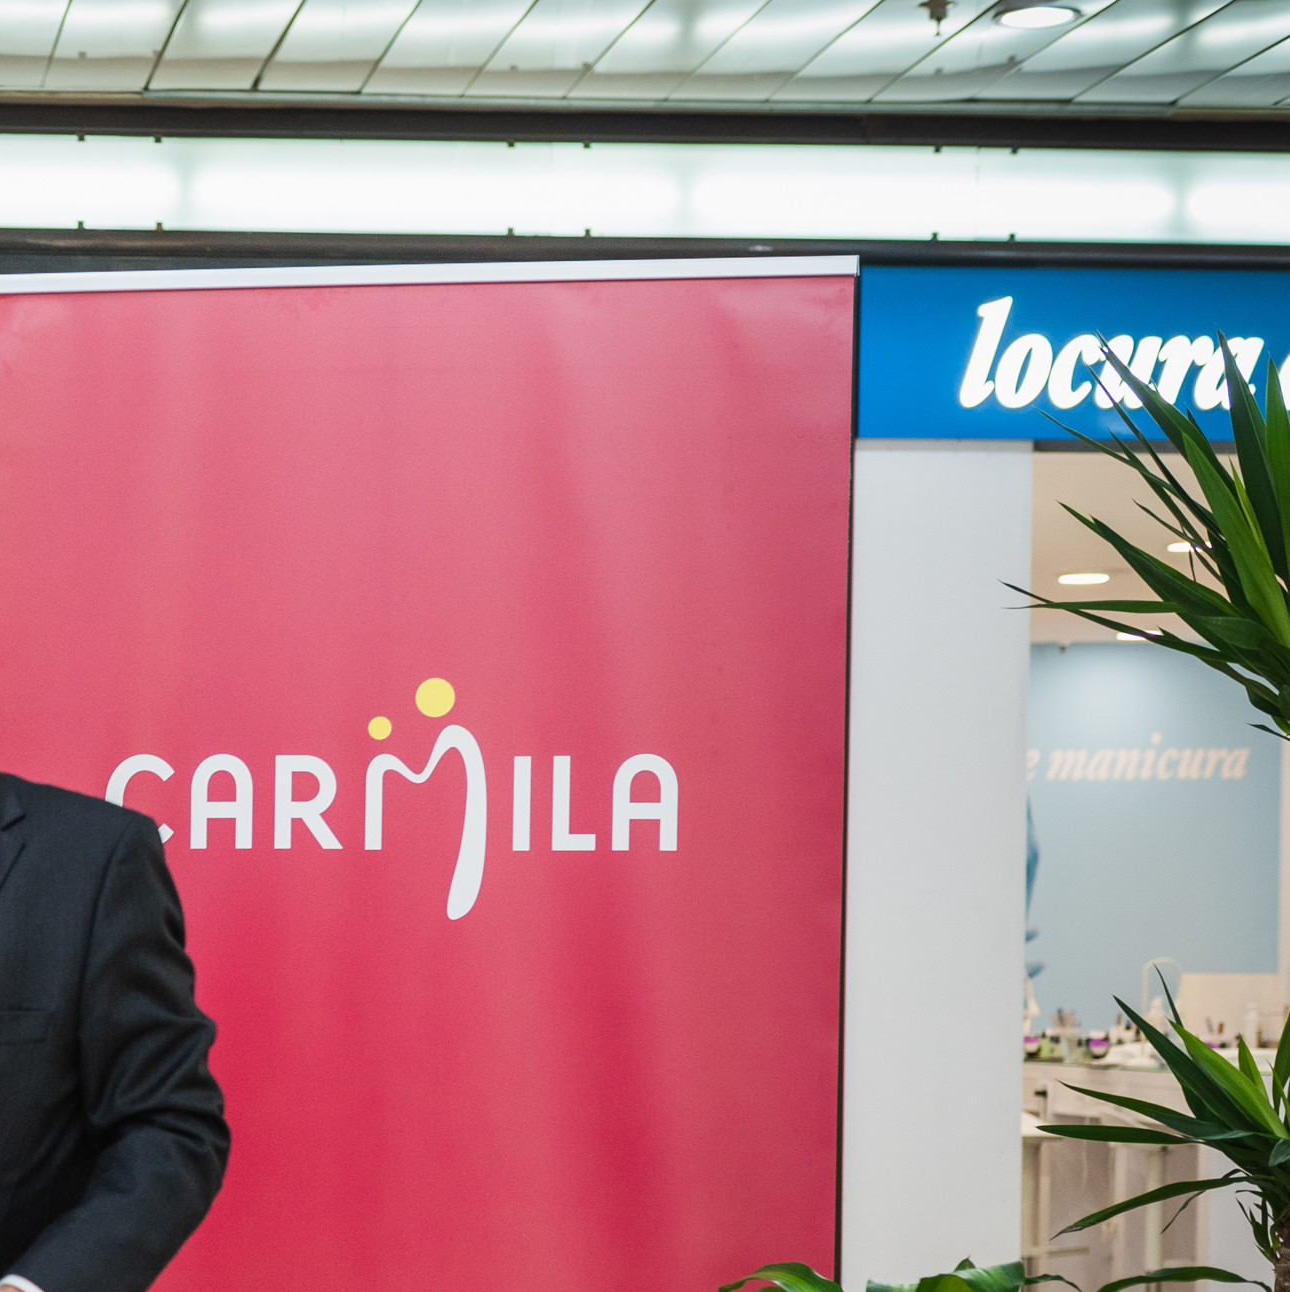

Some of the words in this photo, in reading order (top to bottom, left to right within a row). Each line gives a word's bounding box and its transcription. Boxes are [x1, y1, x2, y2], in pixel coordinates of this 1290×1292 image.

[959, 295, 1265, 411] locura
[1045, 731, 1252, 782] manicura
[105, 723, 679, 920] CARMILA
